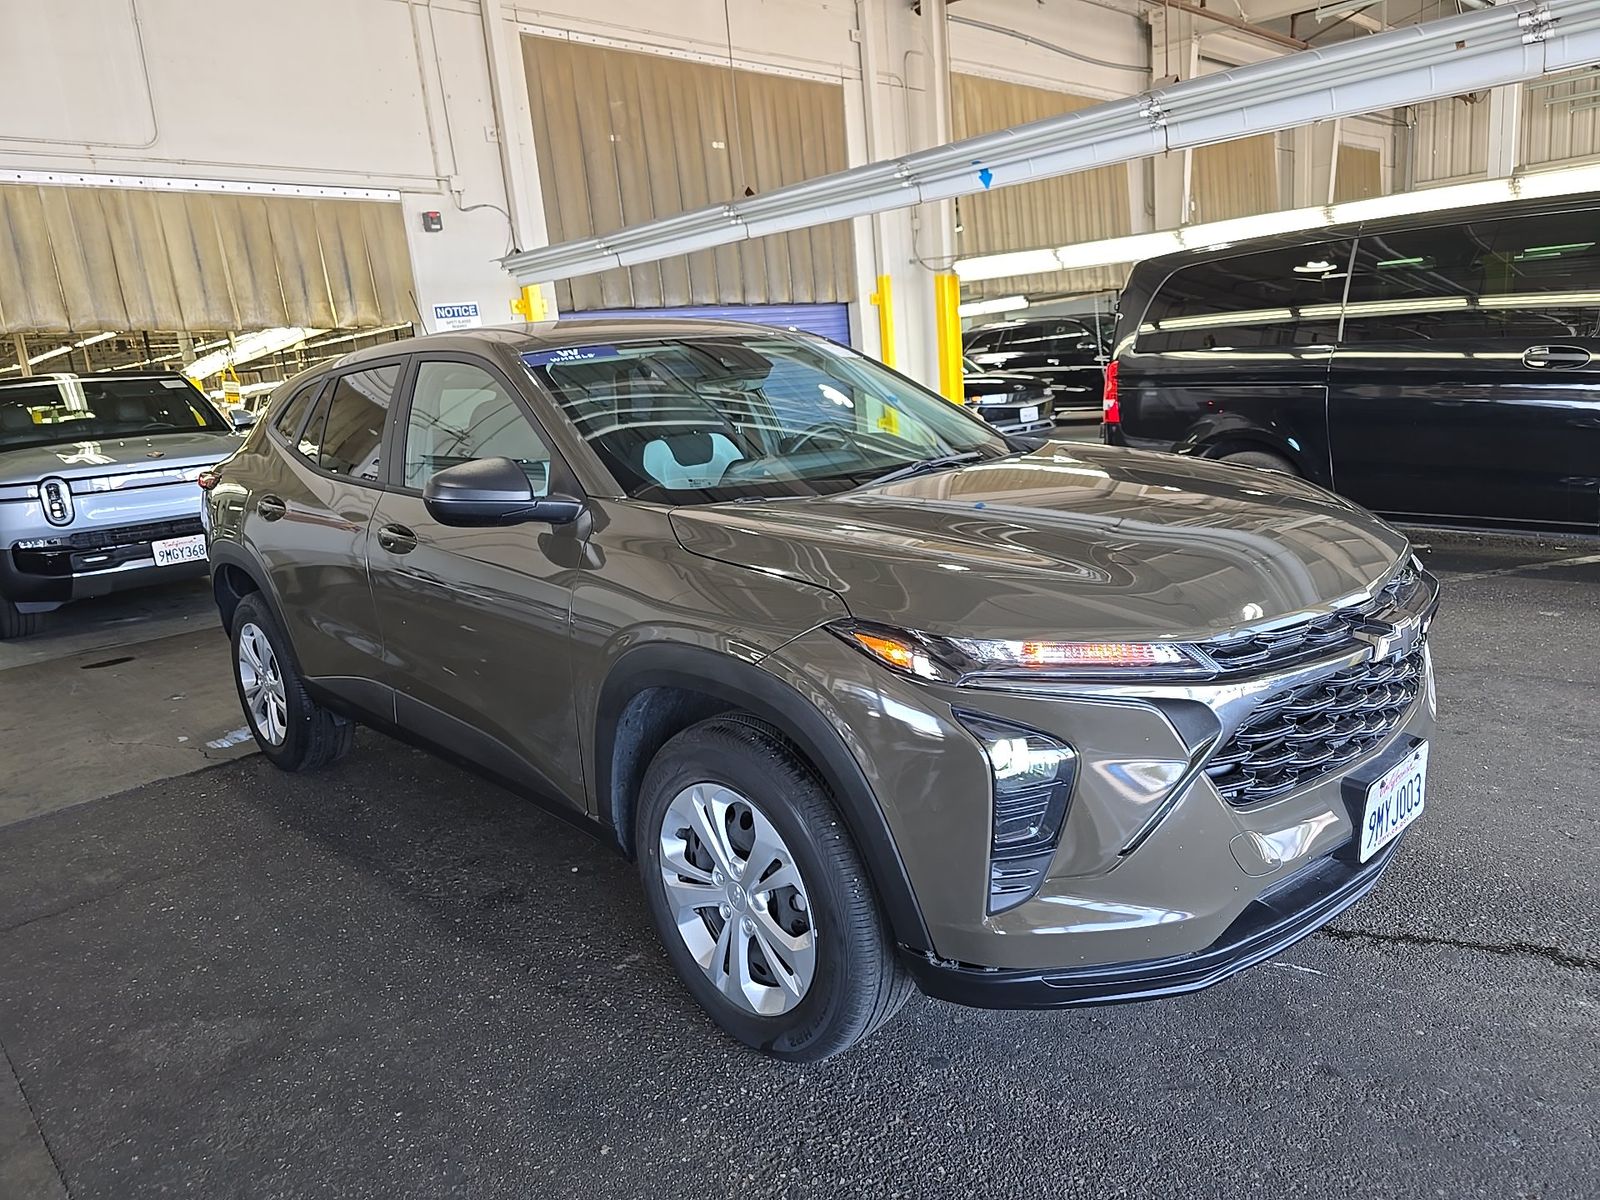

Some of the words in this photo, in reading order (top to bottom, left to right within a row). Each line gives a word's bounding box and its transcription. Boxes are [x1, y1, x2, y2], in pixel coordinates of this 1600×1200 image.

[436, 305, 477, 318] NOTICE
[549, 352, 596, 363] WHEELS
[158, 544, 206, 562] 9MGY368
[1367, 773, 1421, 849] 9MYJ003
